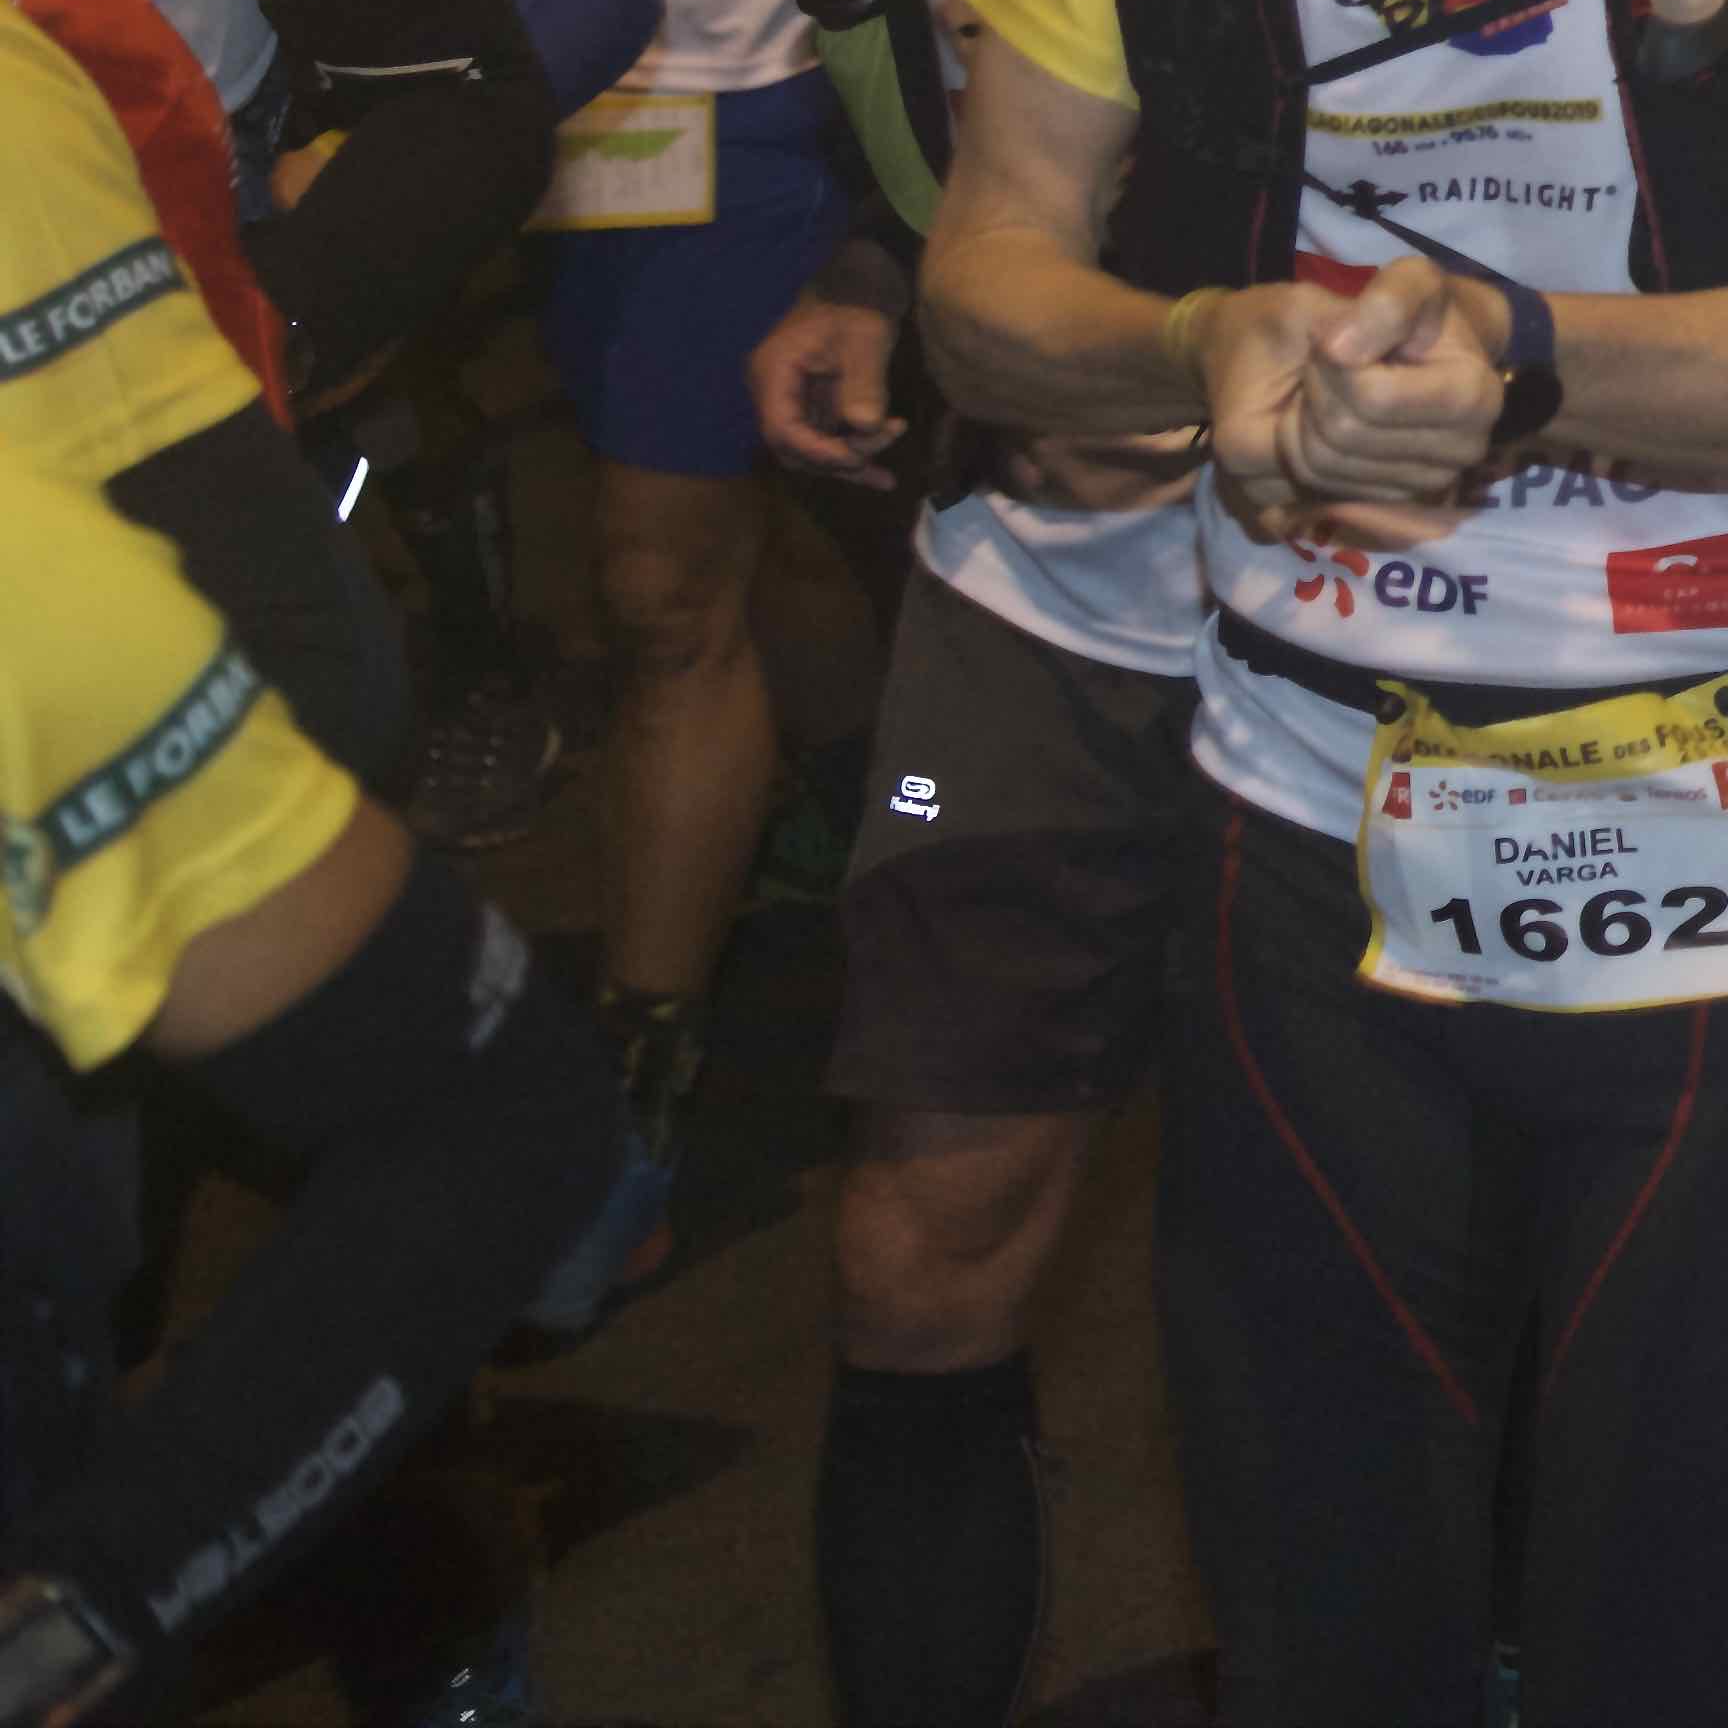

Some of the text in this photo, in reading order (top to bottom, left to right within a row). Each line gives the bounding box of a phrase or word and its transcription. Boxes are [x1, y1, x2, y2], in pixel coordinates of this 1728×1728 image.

[1418, 176, 1602, 213] RAIDLIGHT
[0, 319, 47, 365] LE
[57, 776, 129, 850] LE
[1493, 827, 1640, 865] DANIEL
[1515, 861, 1619, 888] VARGA
